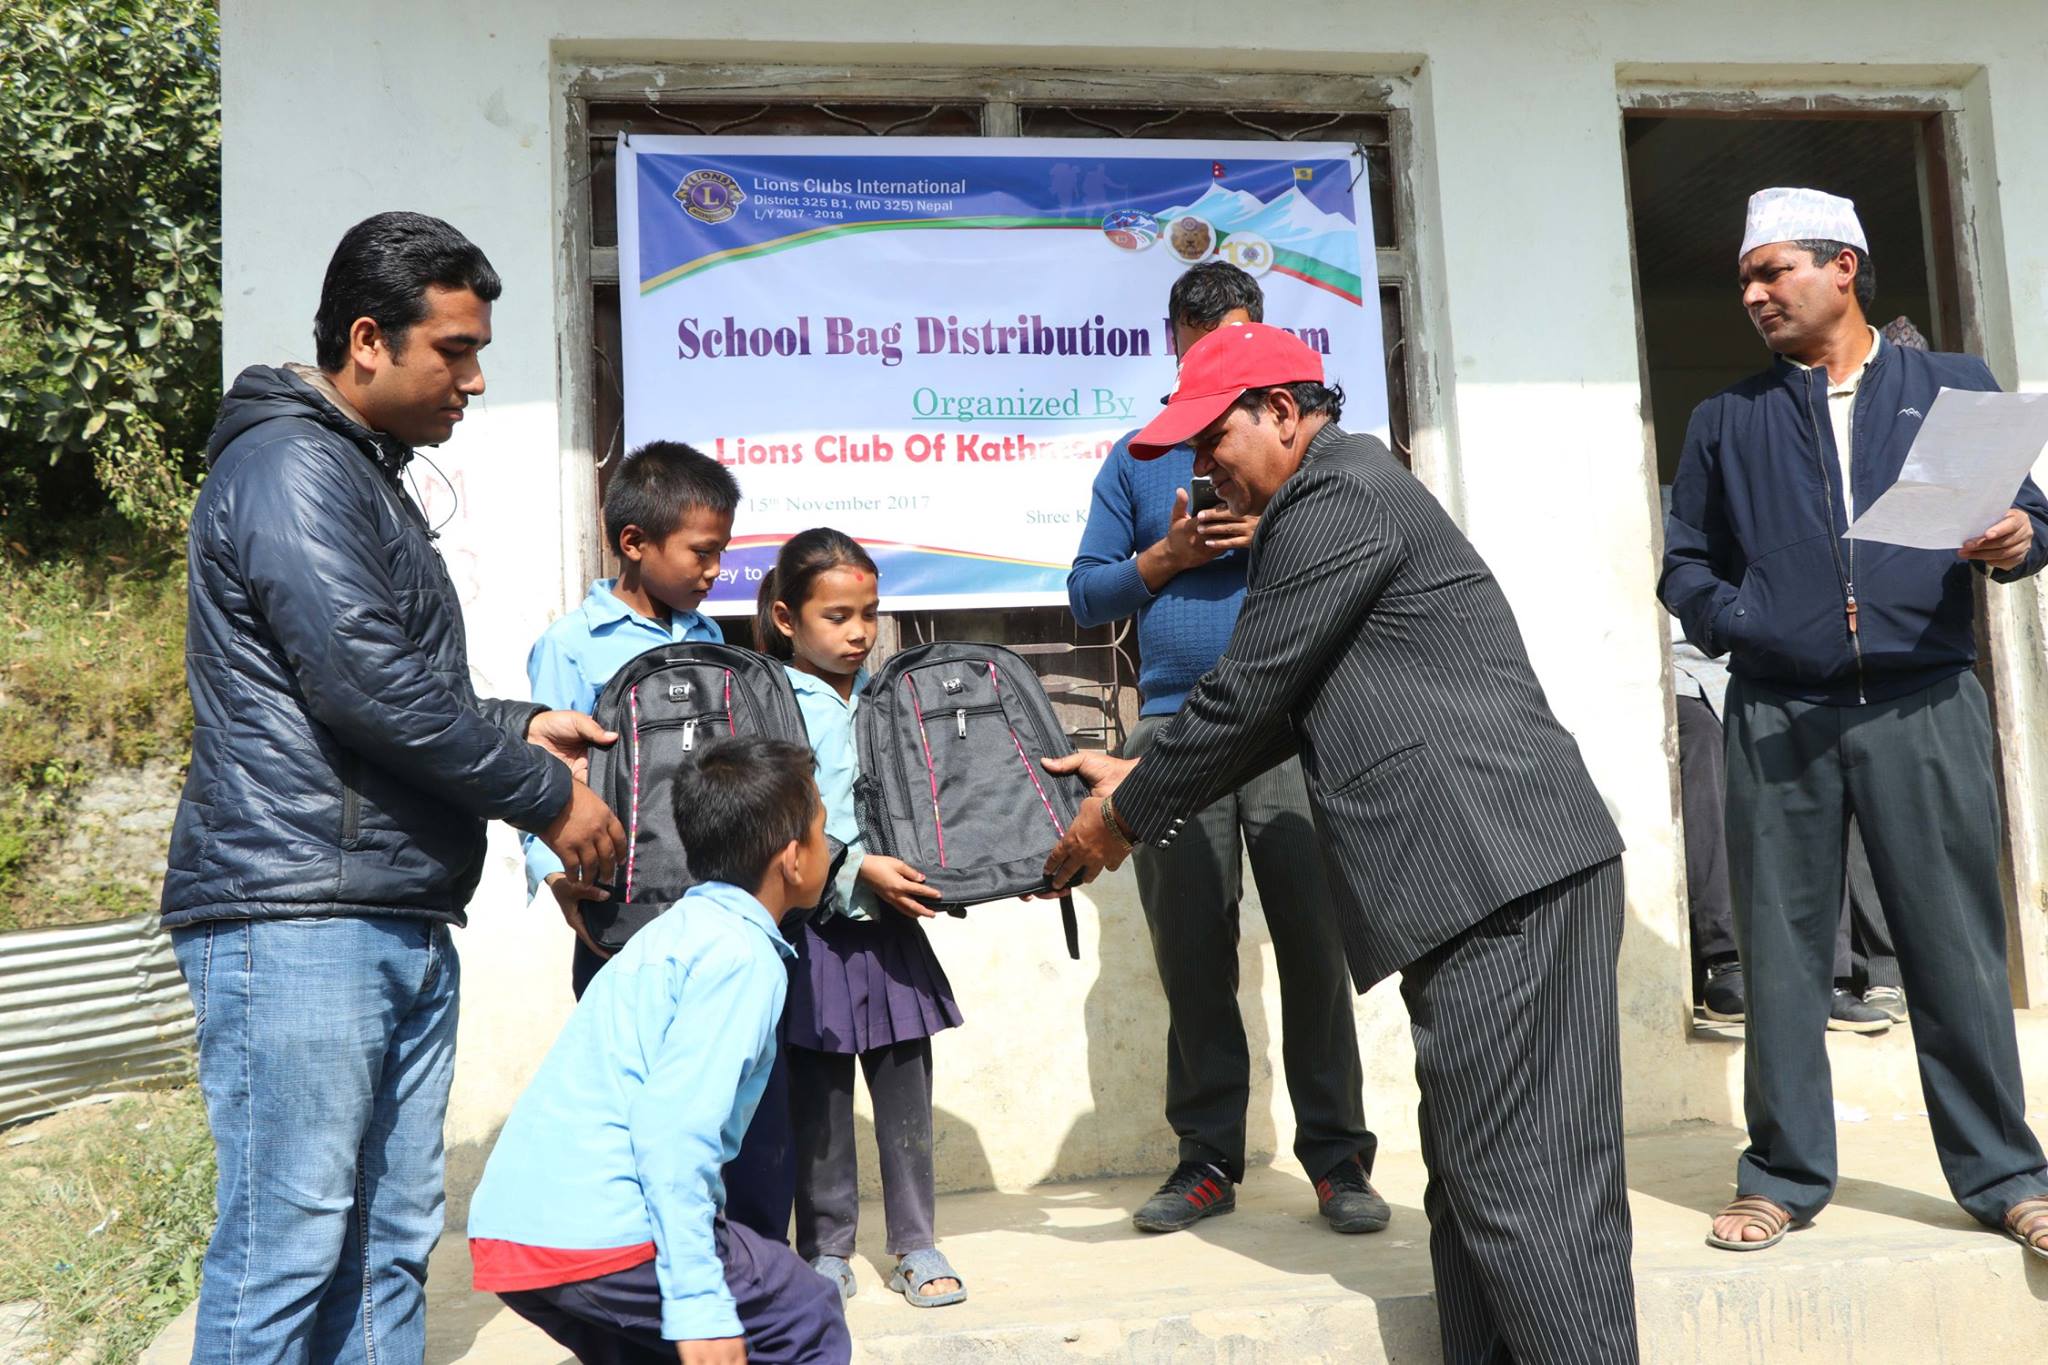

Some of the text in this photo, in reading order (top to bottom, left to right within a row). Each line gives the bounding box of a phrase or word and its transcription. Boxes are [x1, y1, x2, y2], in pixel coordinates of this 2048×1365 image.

[689, 172, 730, 185] LIONS
[753, 177, 966, 194] Lions Clubs International
[702, 187, 719, 205] L
[754, 194, 800, 206] District
[802, 197, 828, 208] 325
[855, 200, 880, 211] (MD
[884, 200, 914, 212] 325)
[917, 200, 953, 213] Nepal
[754, 209, 774, 221] L/Y
[777, 209, 805, 219] 2017
[814, 210, 844, 220] 2018
[678, 316, 811, 360] School
[824, 316, 903, 367] Bag
[914, 314, 1152, 357] Distribution
[912, 387, 1135, 422] Organized By
[715, 437, 803, 465] Lions
[815, 435, 894, 463] Club
[905, 433, 946, 463] Of
[786, 497, 881, 512] November
[888, 495, 930, 511] 2017
[1026, 509, 1071, 524] Shree
[744, 566, 763, 581] to
